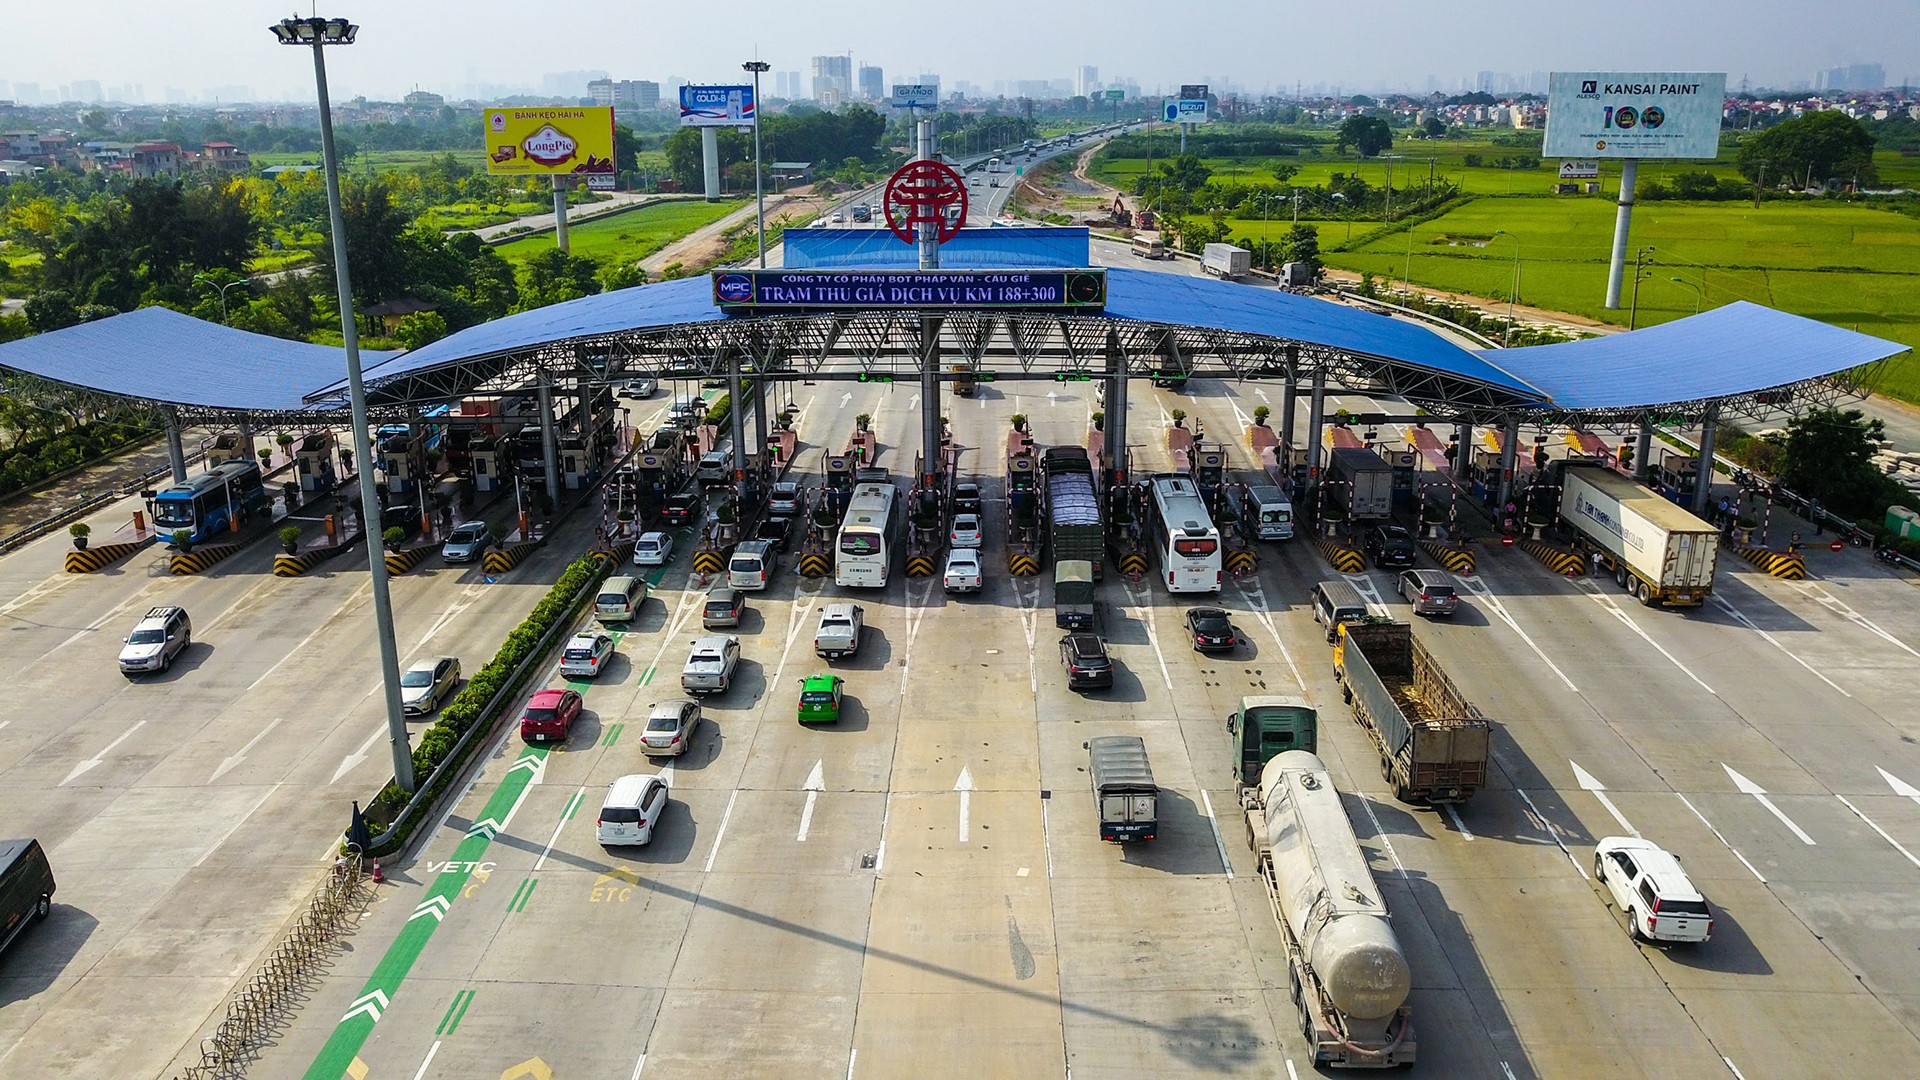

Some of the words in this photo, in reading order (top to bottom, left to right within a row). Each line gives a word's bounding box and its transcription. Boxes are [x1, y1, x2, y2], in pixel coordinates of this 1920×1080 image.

[1604, 84, 1656, 94] KANSAI
[1660, 84, 1700, 94] PAINT
[1604, 106, 1665, 129] 100
[721, 283, 749, 291] MPC
[762, 287, 810, 304] TRẠM
[816, 287, 851, 301] THU
[855, 284, 885, 301] GIÁ
[891, 288, 932, 304] DỊCH
[937, 288, 960, 304] VỤ
[966, 288, 992, 301] KM
[998, 287, 1056, 301] 188+300
[427, 861, 497, 873] VETC
[589, 887, 632, 903] ETC
